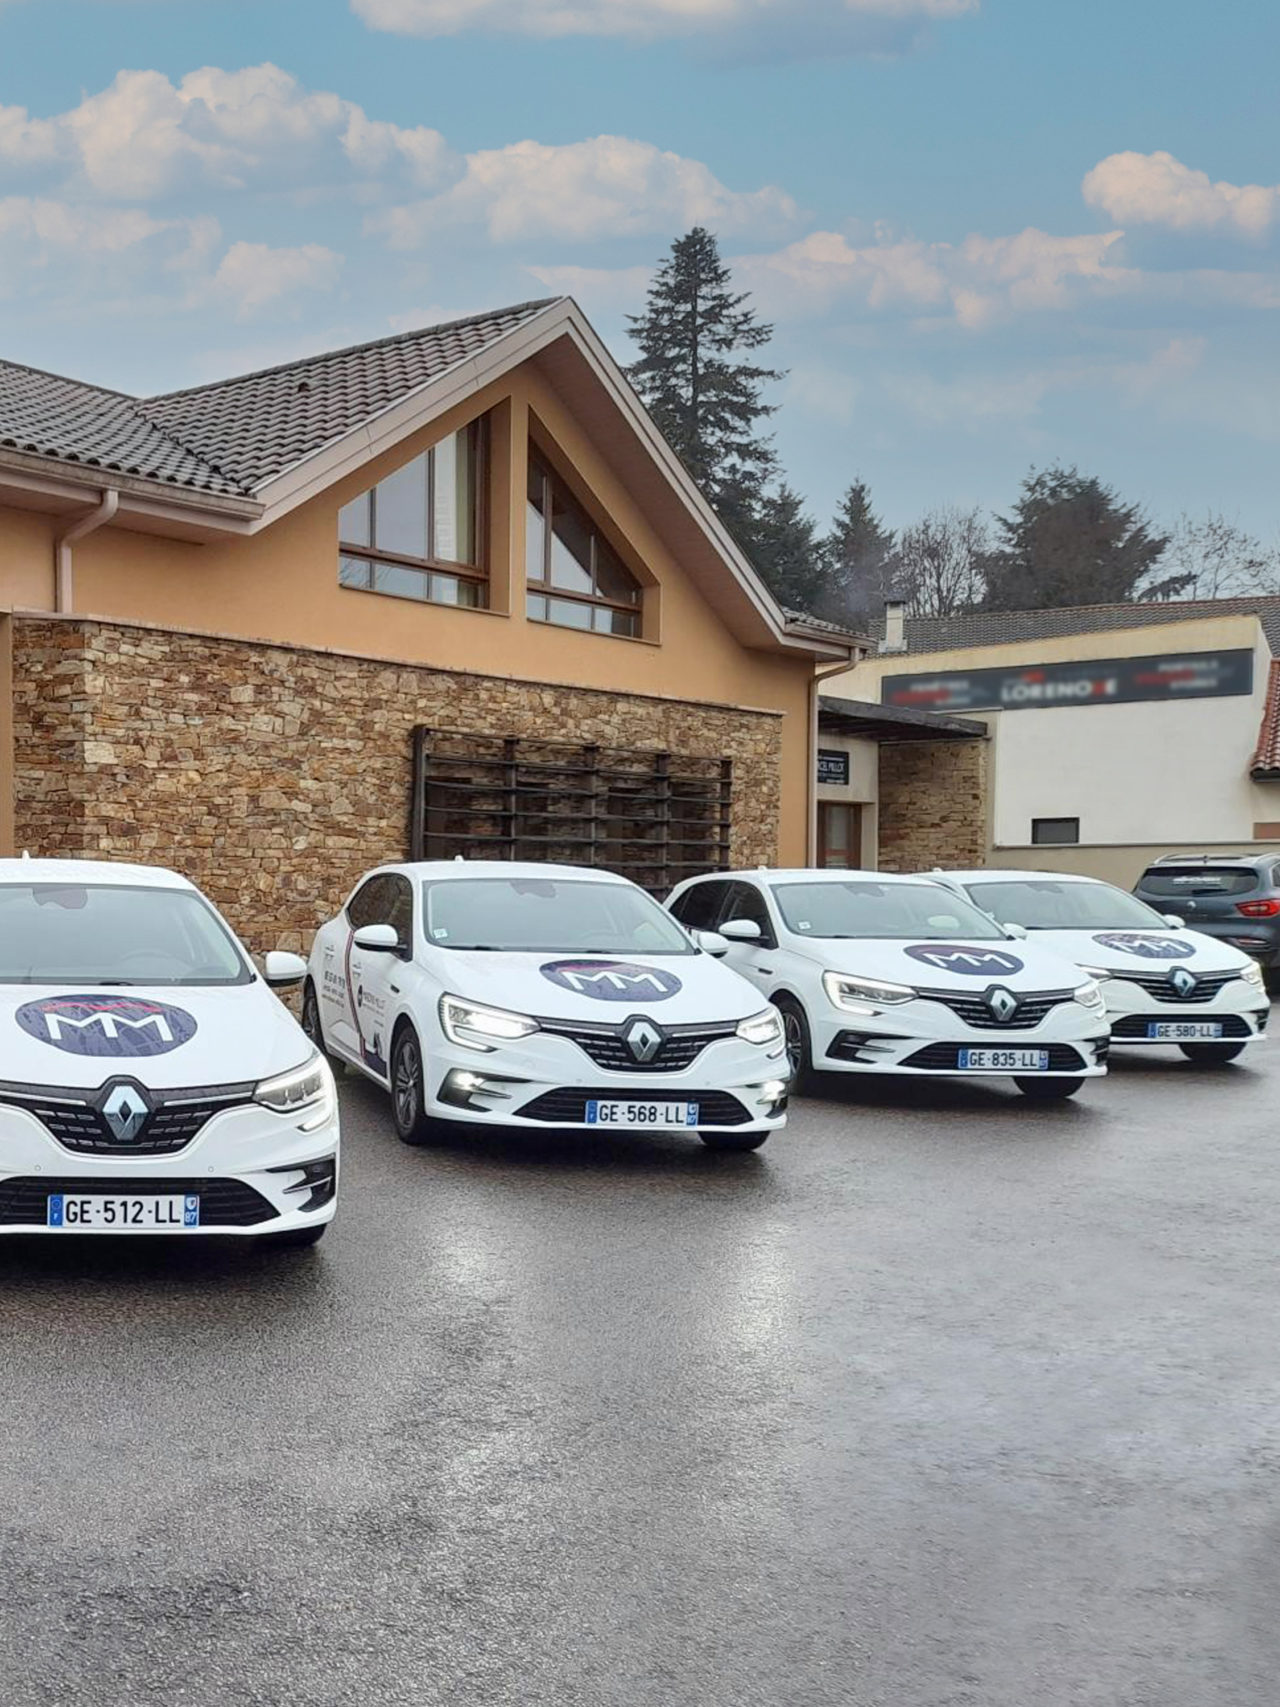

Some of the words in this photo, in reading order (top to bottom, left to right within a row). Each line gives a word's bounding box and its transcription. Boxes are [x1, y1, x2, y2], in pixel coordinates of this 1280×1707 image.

[969, 1051, 1038, 1067] GE-835-LL
[599, 1104, 684, 1123] GE-568-LL
[65, 1200, 181, 1224] GE-512-LL
[185, 1211, 197, 1223] 87
